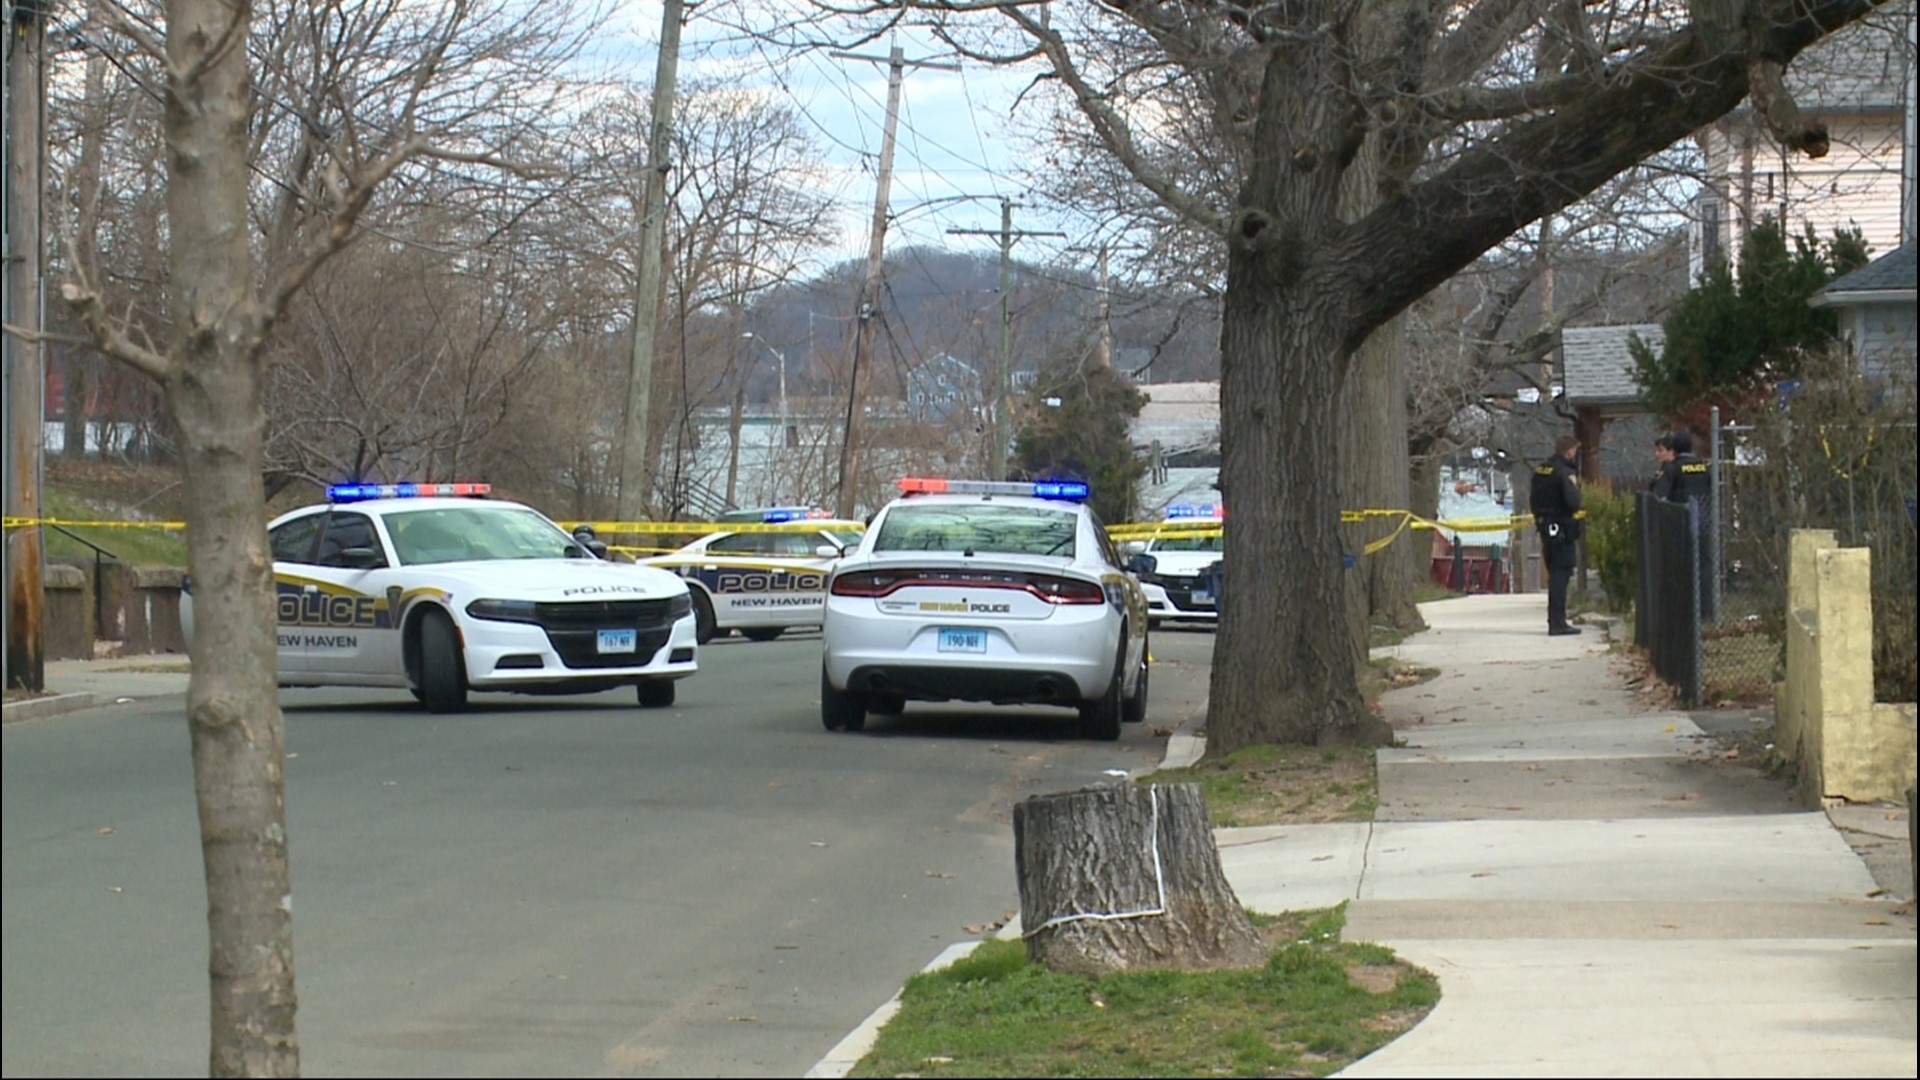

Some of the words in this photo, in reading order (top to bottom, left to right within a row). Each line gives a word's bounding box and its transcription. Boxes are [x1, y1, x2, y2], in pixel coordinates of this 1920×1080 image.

[563, 585, 647, 597] POLICE
[731, 598, 766, 607] NEW
[770, 597, 823, 606] HAVEN
[277, 593, 376, 627] OLICE
[970, 604, 1010, 613] POLICE
[277, 635, 300, 647] EW
[304, 635, 358, 647] HAVEN
